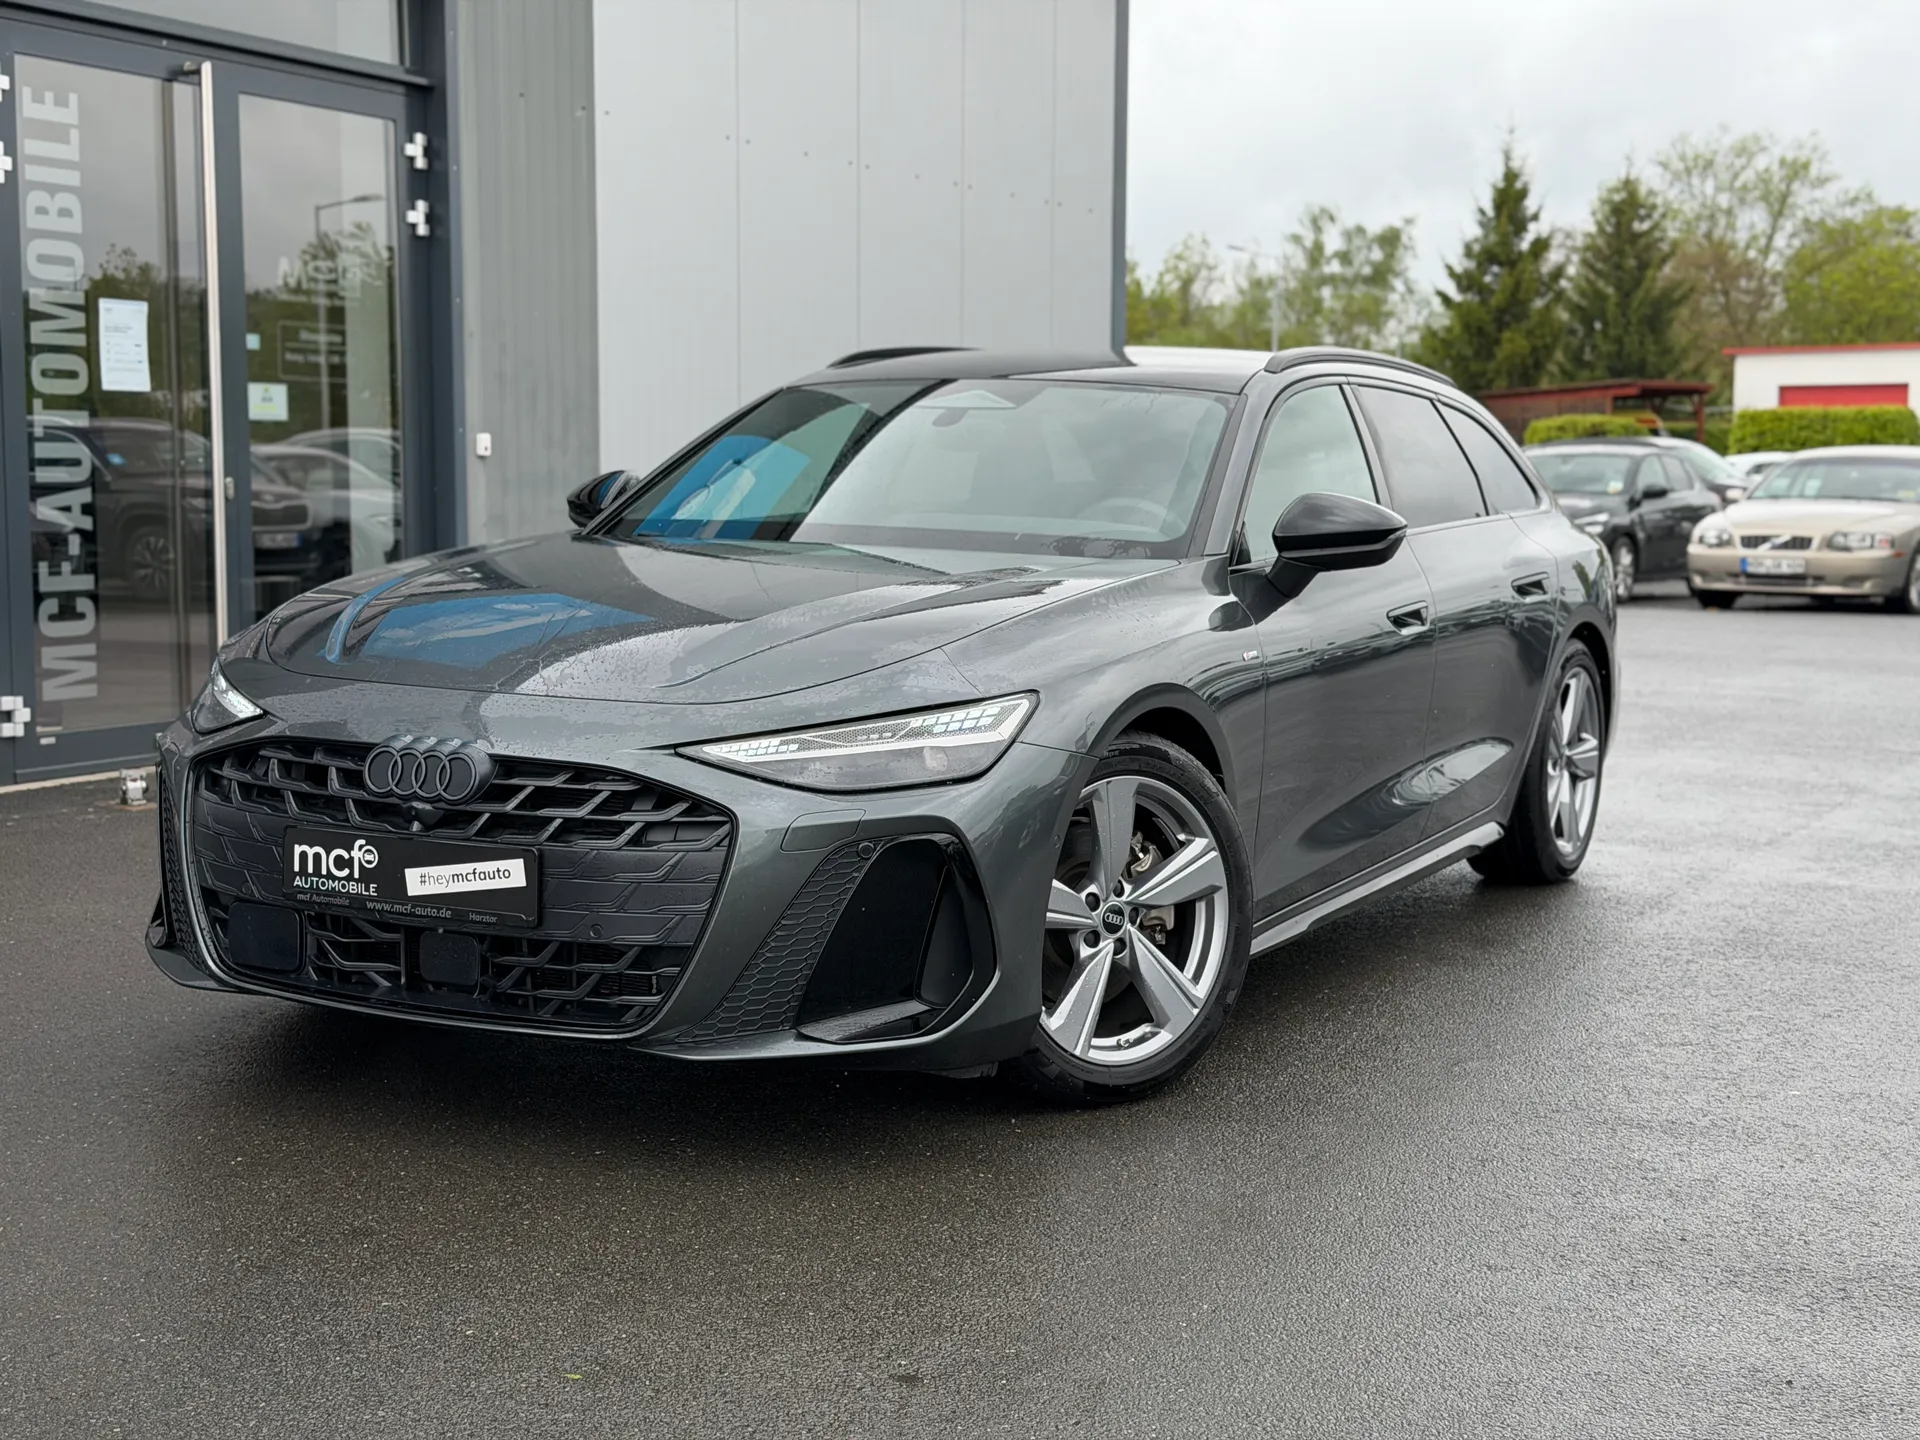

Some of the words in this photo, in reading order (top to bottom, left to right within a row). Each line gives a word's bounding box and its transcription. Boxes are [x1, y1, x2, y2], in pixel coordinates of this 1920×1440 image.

[22, 86, 98, 702] MCF-AUTOMOBILE
[293, 839, 367, 879] mcf
[293, 876, 378, 896] AUTOMOBILE
[419, 867, 512, 889] #heymcfauto
[312, 894, 350, 906] Automobile
[366, 901, 452, 919] www.mcf-auto.de
[469, 912, 498, 924] Harztor
